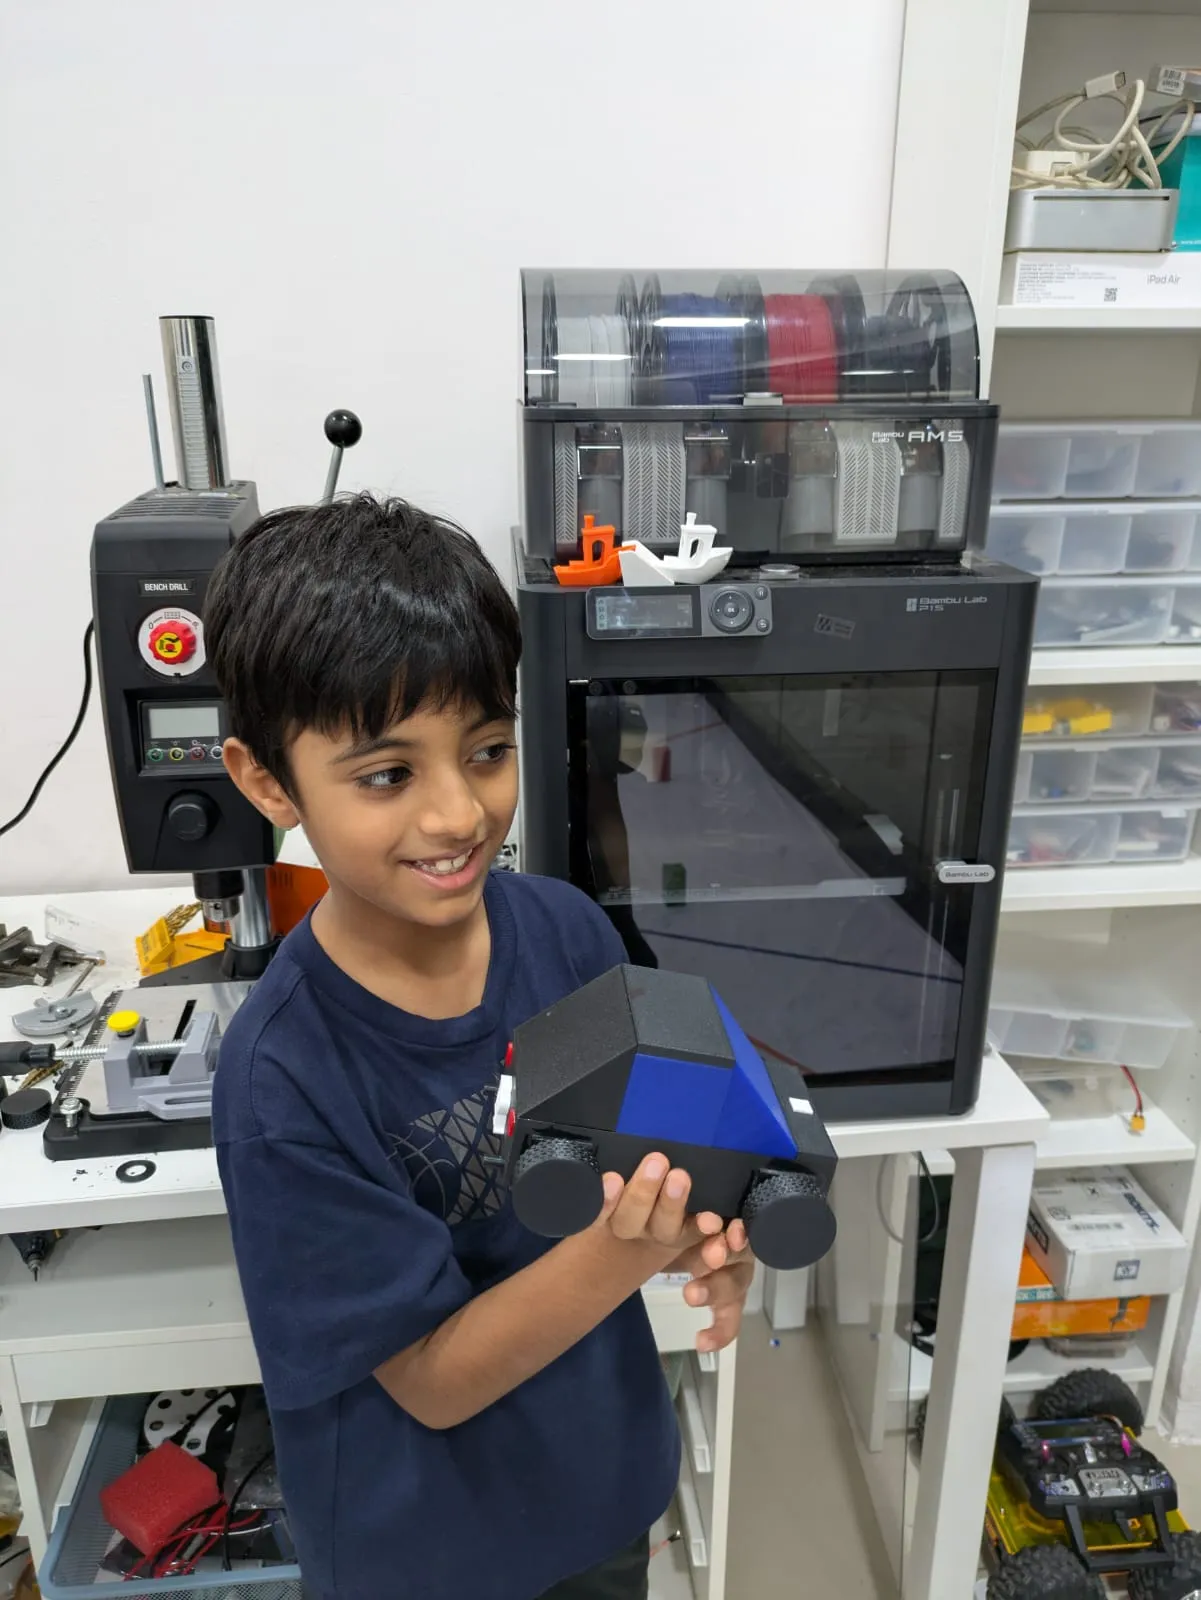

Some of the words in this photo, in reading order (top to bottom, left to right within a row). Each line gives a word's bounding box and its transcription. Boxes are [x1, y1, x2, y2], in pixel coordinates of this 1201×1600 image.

[1146, 274, 1167, 285] iPad
[1168, 274, 1182, 284] Air
[908, 431, 964, 443] AMS
[144, 583, 168, 591] BENCH
[169, 583, 189, 591] DRILL
[919, 597, 961, 605] Bambu
[963, 596, 988, 604] Lab
